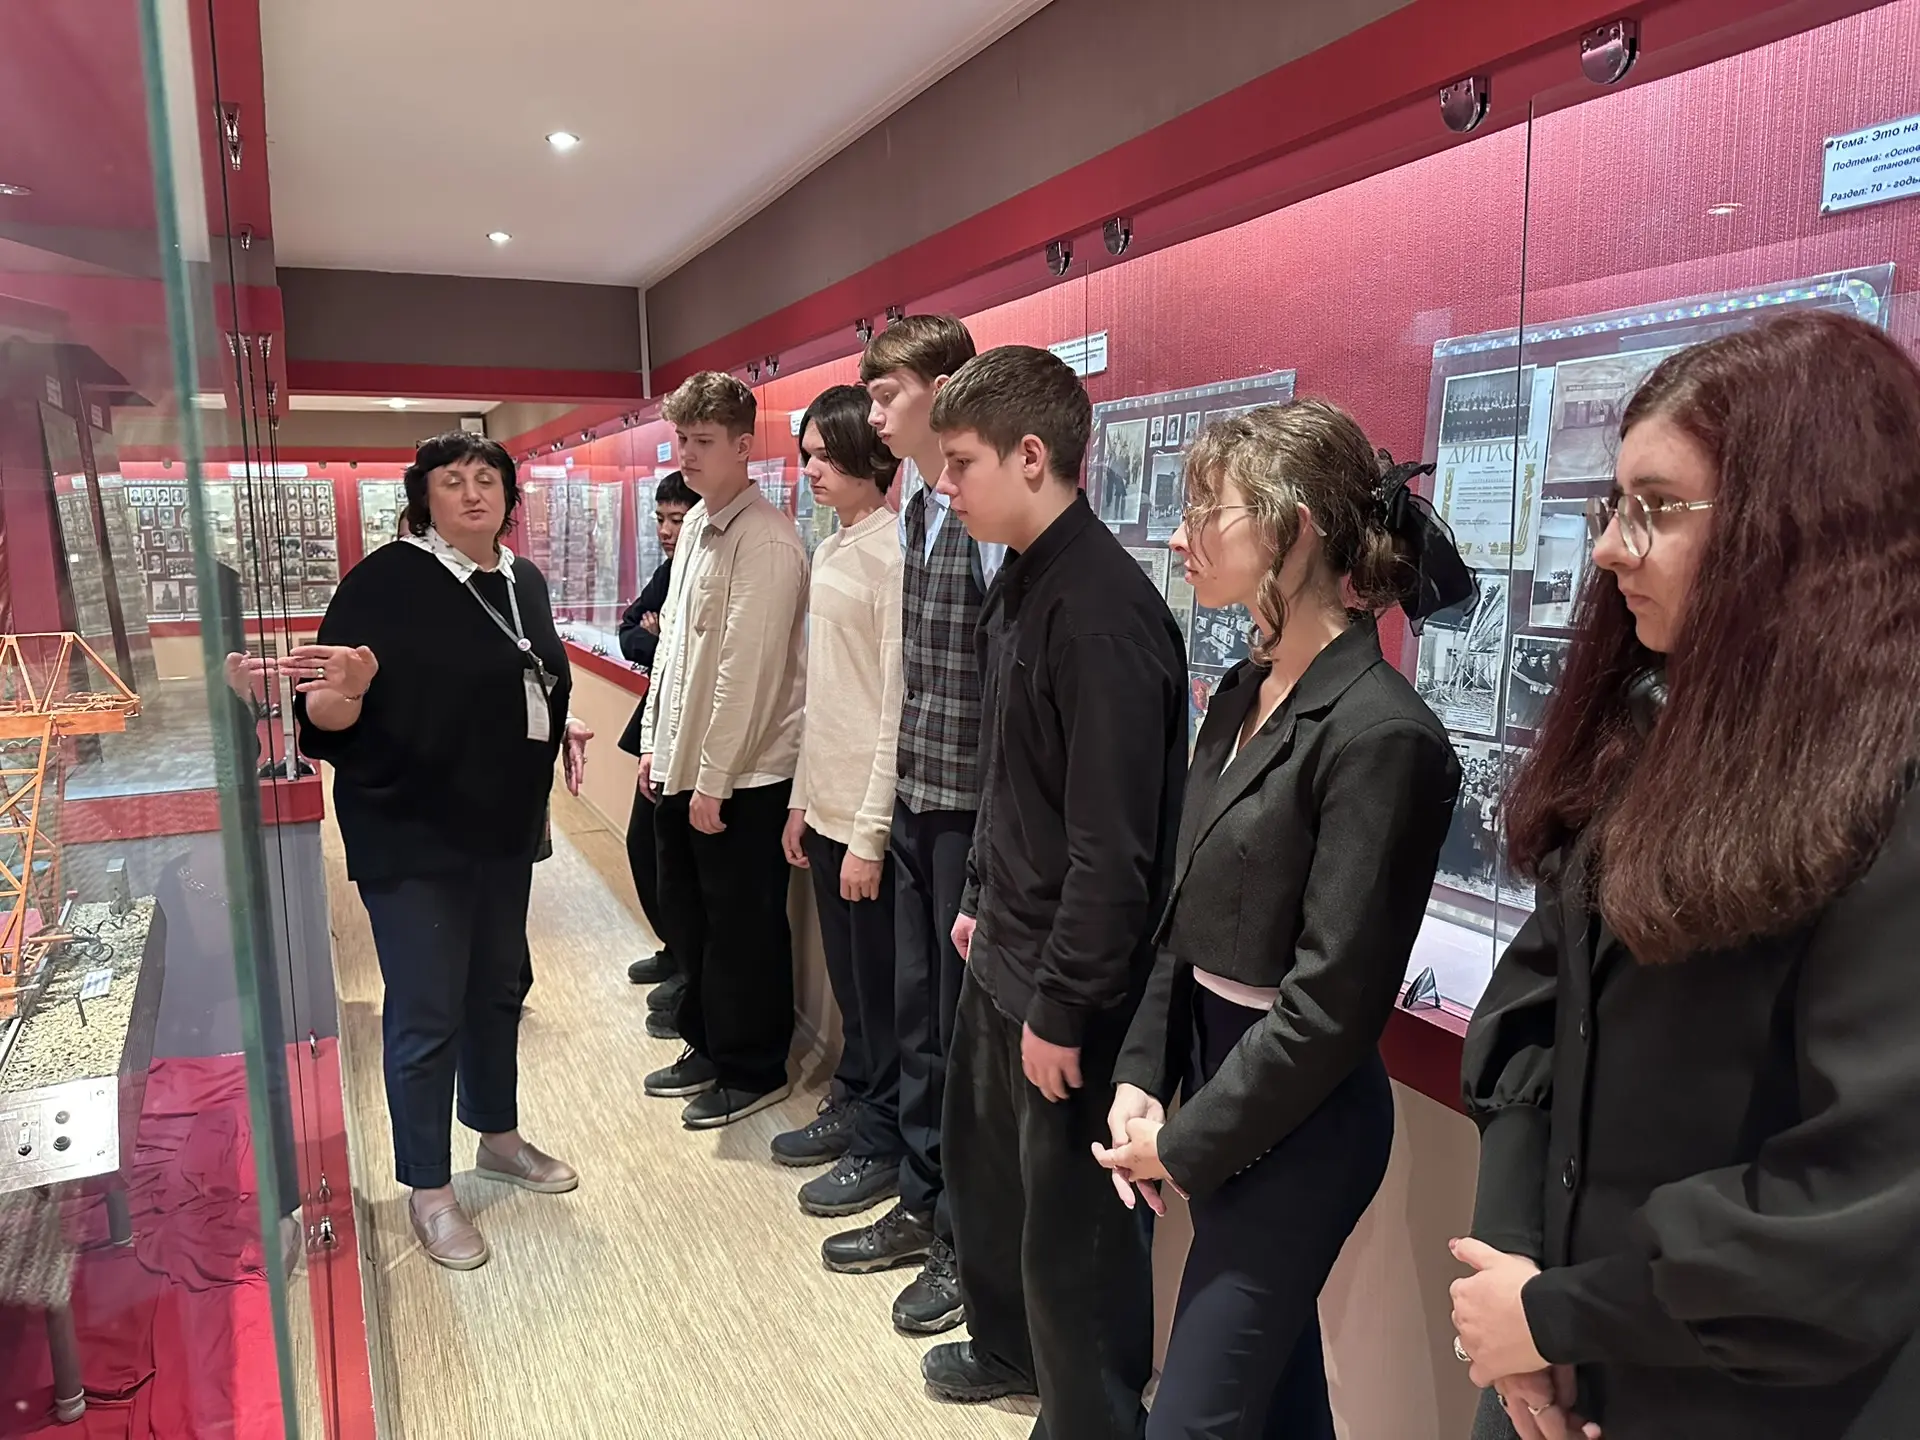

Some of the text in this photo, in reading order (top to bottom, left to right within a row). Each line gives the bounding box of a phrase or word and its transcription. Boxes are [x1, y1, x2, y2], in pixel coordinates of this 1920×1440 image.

[1835, 122, 1920, 151] Тема: Это на
[1832, 153, 1882, 172] Подтема:
[1830, 186, 1868, 202] Раздел:
[1871, 182, 1882, 193] 70
[1446, 441, 1539, 464] ДИПЛОМ
